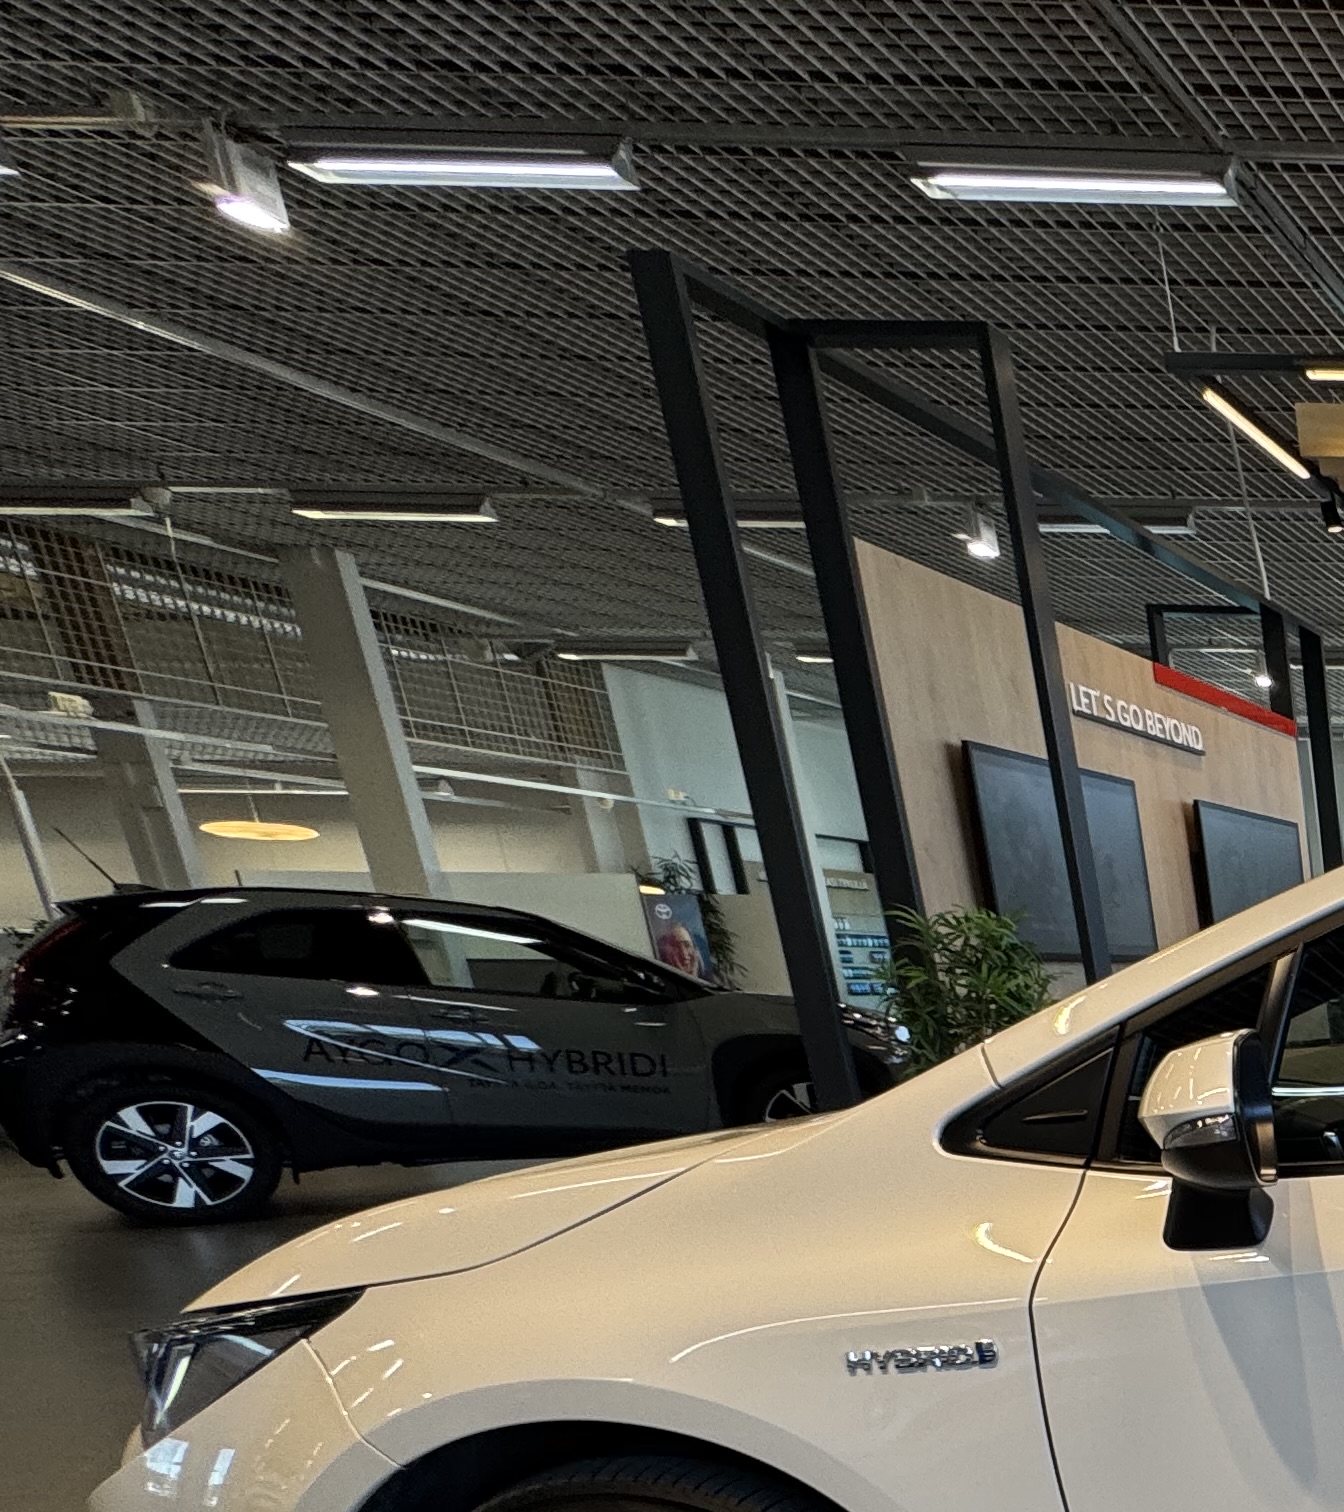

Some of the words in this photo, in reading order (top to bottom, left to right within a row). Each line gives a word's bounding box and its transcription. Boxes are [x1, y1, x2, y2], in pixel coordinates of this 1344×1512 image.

[1116, 700, 1144, 732] GO
[1146, 708, 1204, 751] BEYOND
[303, 1036, 430, 1067] AYGO
[507, 1048, 670, 1078] HYBRIDI
[846, 1344, 976, 1374] HYBRID
